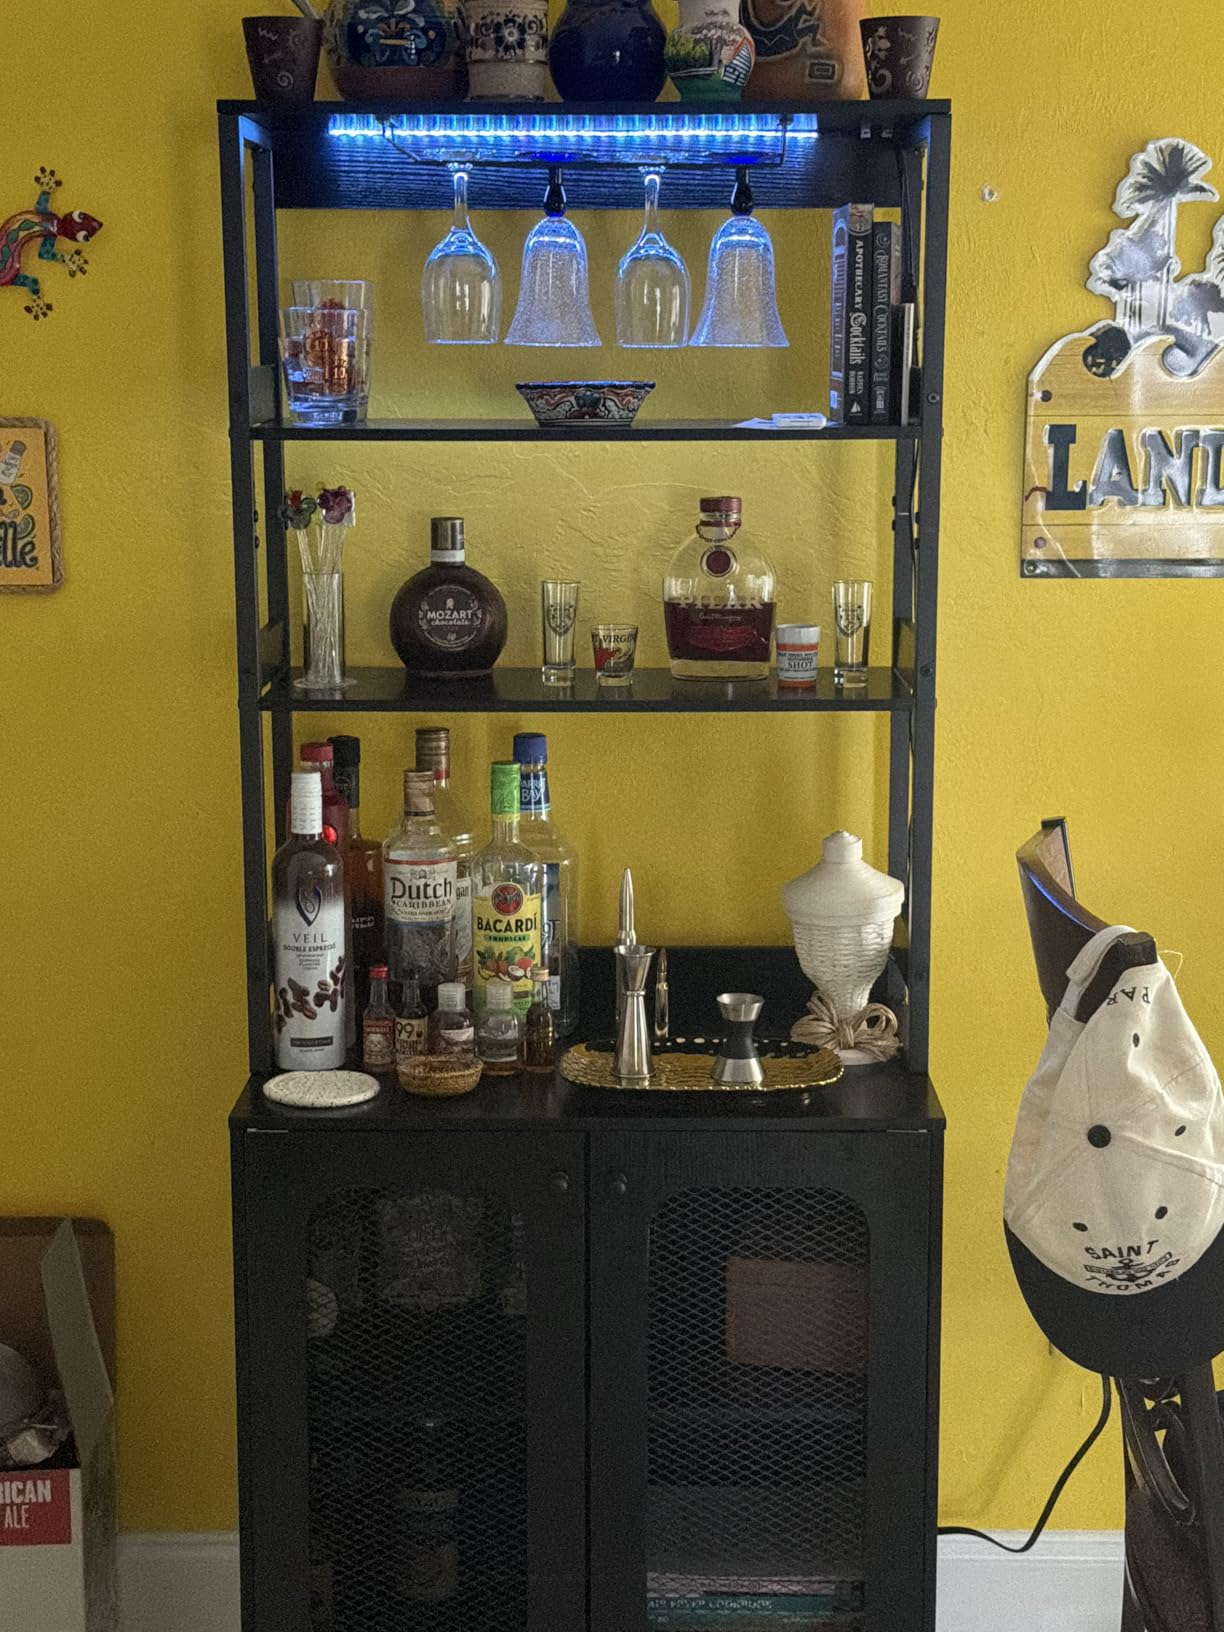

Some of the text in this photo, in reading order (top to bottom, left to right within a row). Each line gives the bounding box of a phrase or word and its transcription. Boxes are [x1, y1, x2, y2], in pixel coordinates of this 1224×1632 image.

[855, 240, 864, 312] APOTHECARY
[874, 250, 889, 353] ROMANTASY COCKTAILS
[849, 312, 867, 365] Cocktails
[0, 520, 38, 567] lle
[427, 610, 473, 620] MOZART
[788, 661, 812, 669] SHOT
[521, 788, 543, 802] BAY
[390, 877, 452, 904] Dutch
[456, 886, 469, 901] gan
[396, 898, 452, 910] CARIBBEAN
[477, 912, 537, 933] BACARDÍ
[283, 943, 336, 952] DOUBLE ESPRESSO
[293, 933, 327, 944] VEIL
[396, 1021, 415, 1039] 99
[1084, 1239, 1159, 1260] SAINT
[1085, 1258, 1180, 1291] THOMAS
[4, 1505, 30, 1528] ALE
